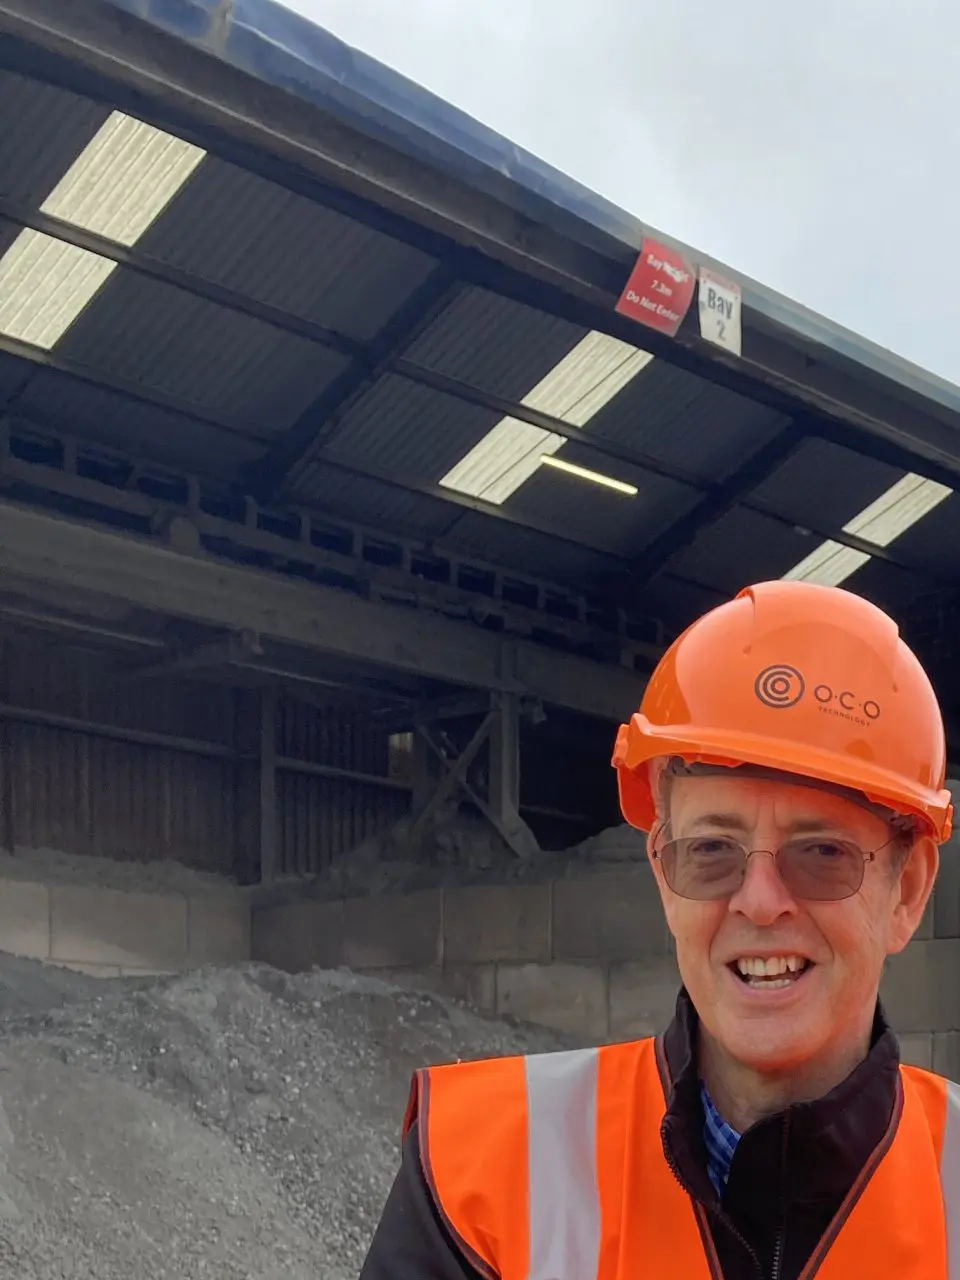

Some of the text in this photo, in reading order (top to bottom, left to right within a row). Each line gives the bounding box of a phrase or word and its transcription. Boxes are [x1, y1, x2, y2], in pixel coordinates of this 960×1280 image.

[626, 290, 680, 321] Do Not Enter
[707, 287, 733, 320] Bay
[716, 320, 726, 341] 2
[818, 706, 870, 727] TECHNOLOGY
